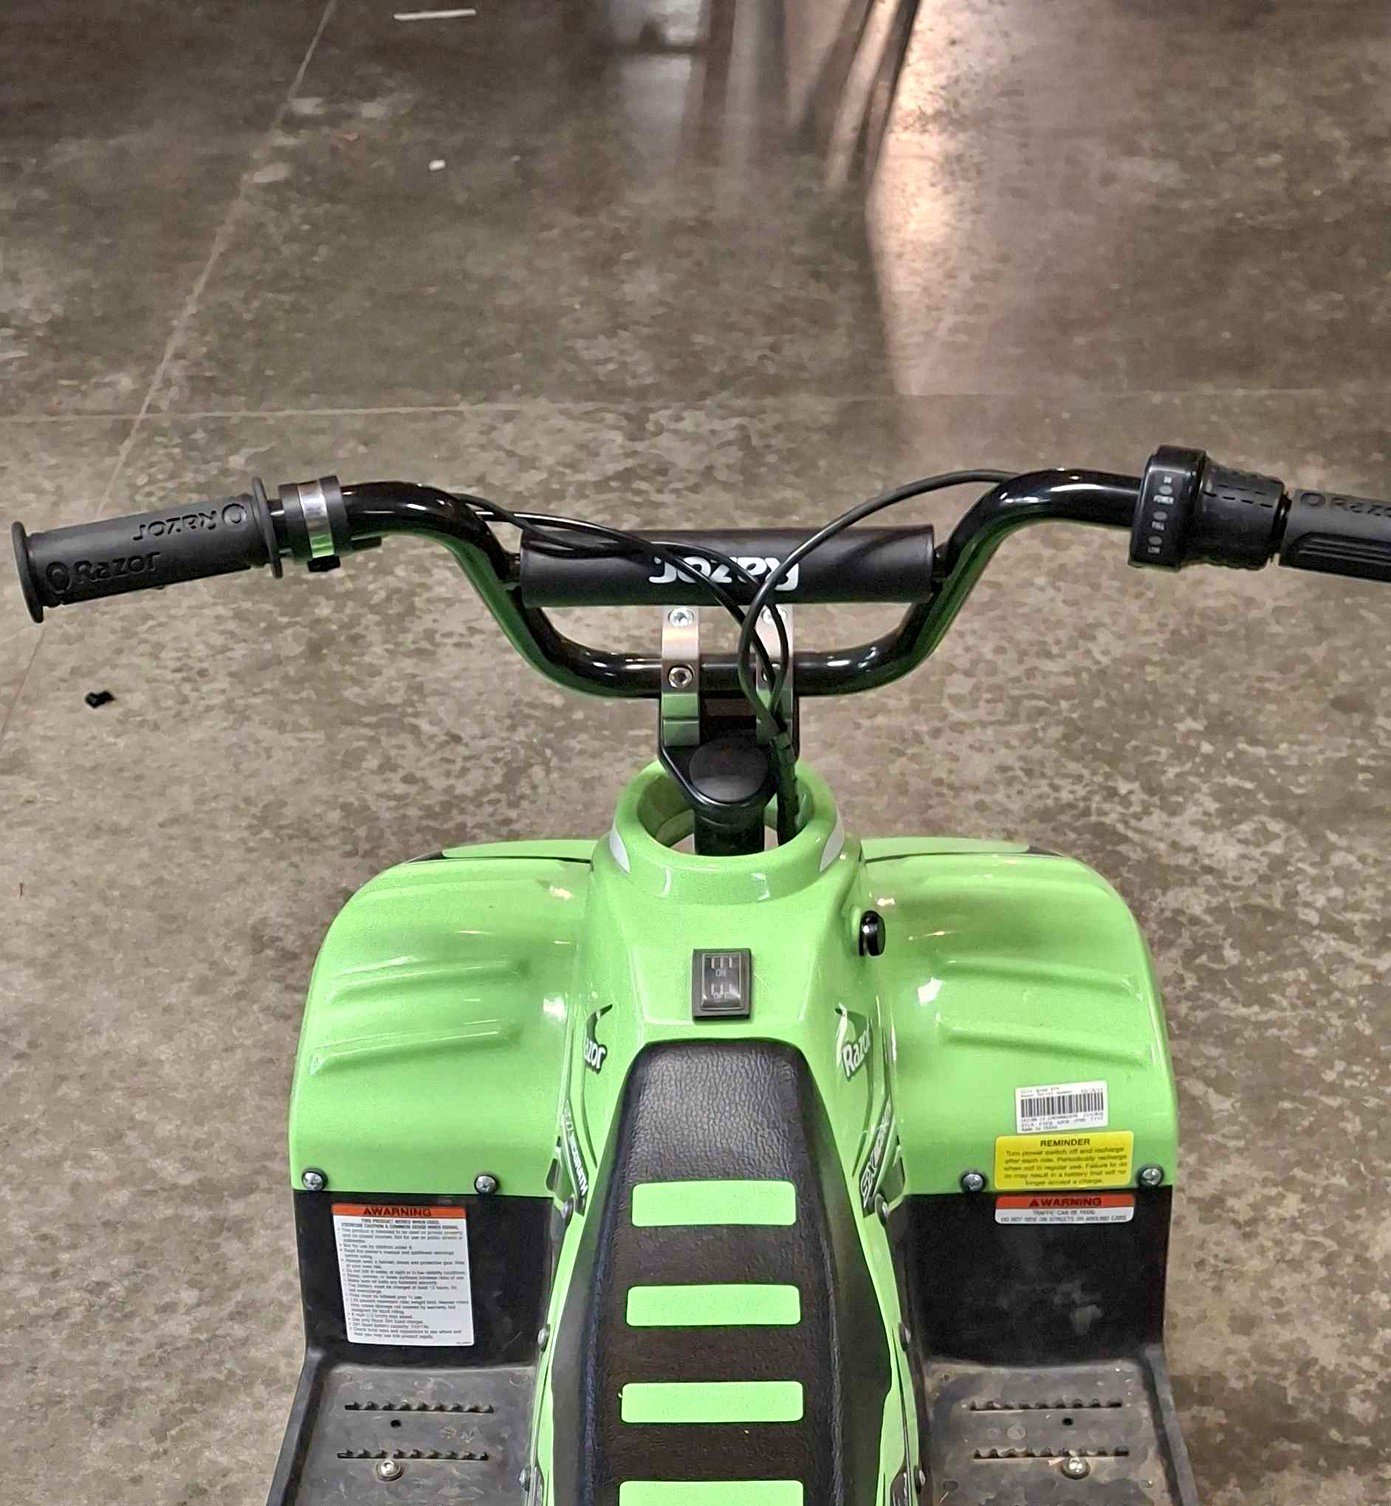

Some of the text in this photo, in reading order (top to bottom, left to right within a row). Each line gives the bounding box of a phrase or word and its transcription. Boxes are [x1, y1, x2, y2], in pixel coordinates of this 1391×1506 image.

[72, 550, 160, 585] Razor
[1040, 1138, 1091, 1147] REMINDER
[1040, 1197, 1103, 1207] WARNING
[370, 1206, 432, 1217] WARNING
